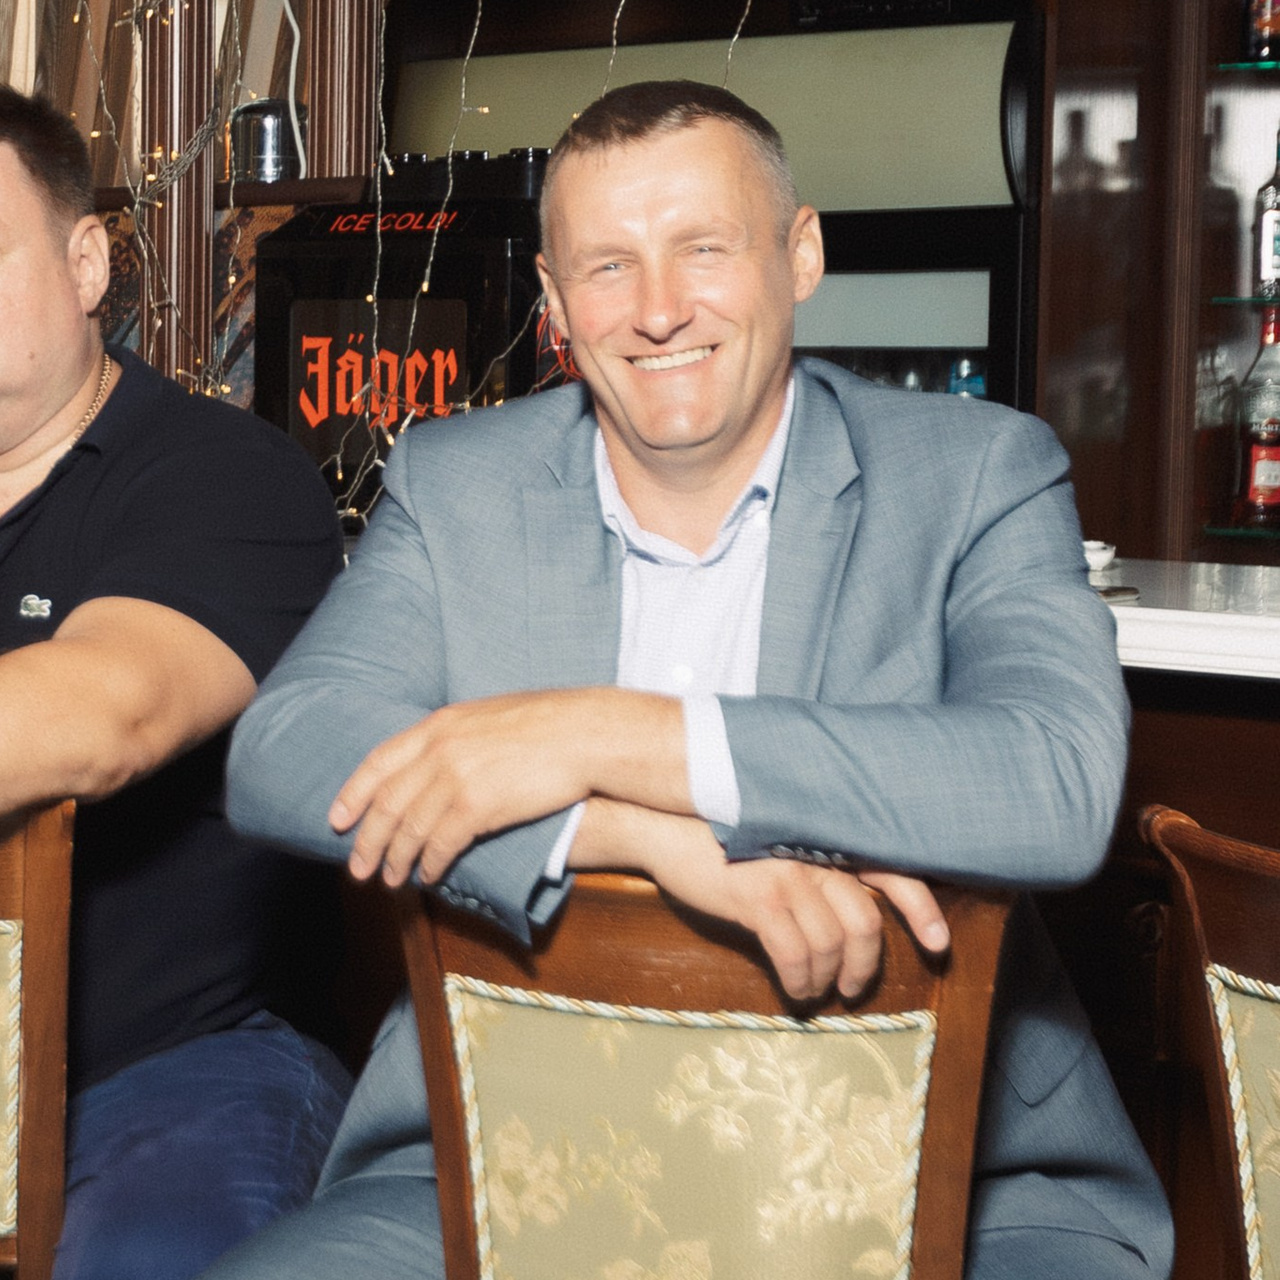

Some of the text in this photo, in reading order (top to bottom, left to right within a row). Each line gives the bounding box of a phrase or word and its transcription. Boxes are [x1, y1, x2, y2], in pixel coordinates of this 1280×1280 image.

[329, 210, 459, 233] ICE COLD!
[298, 332, 459, 430] Jäger
